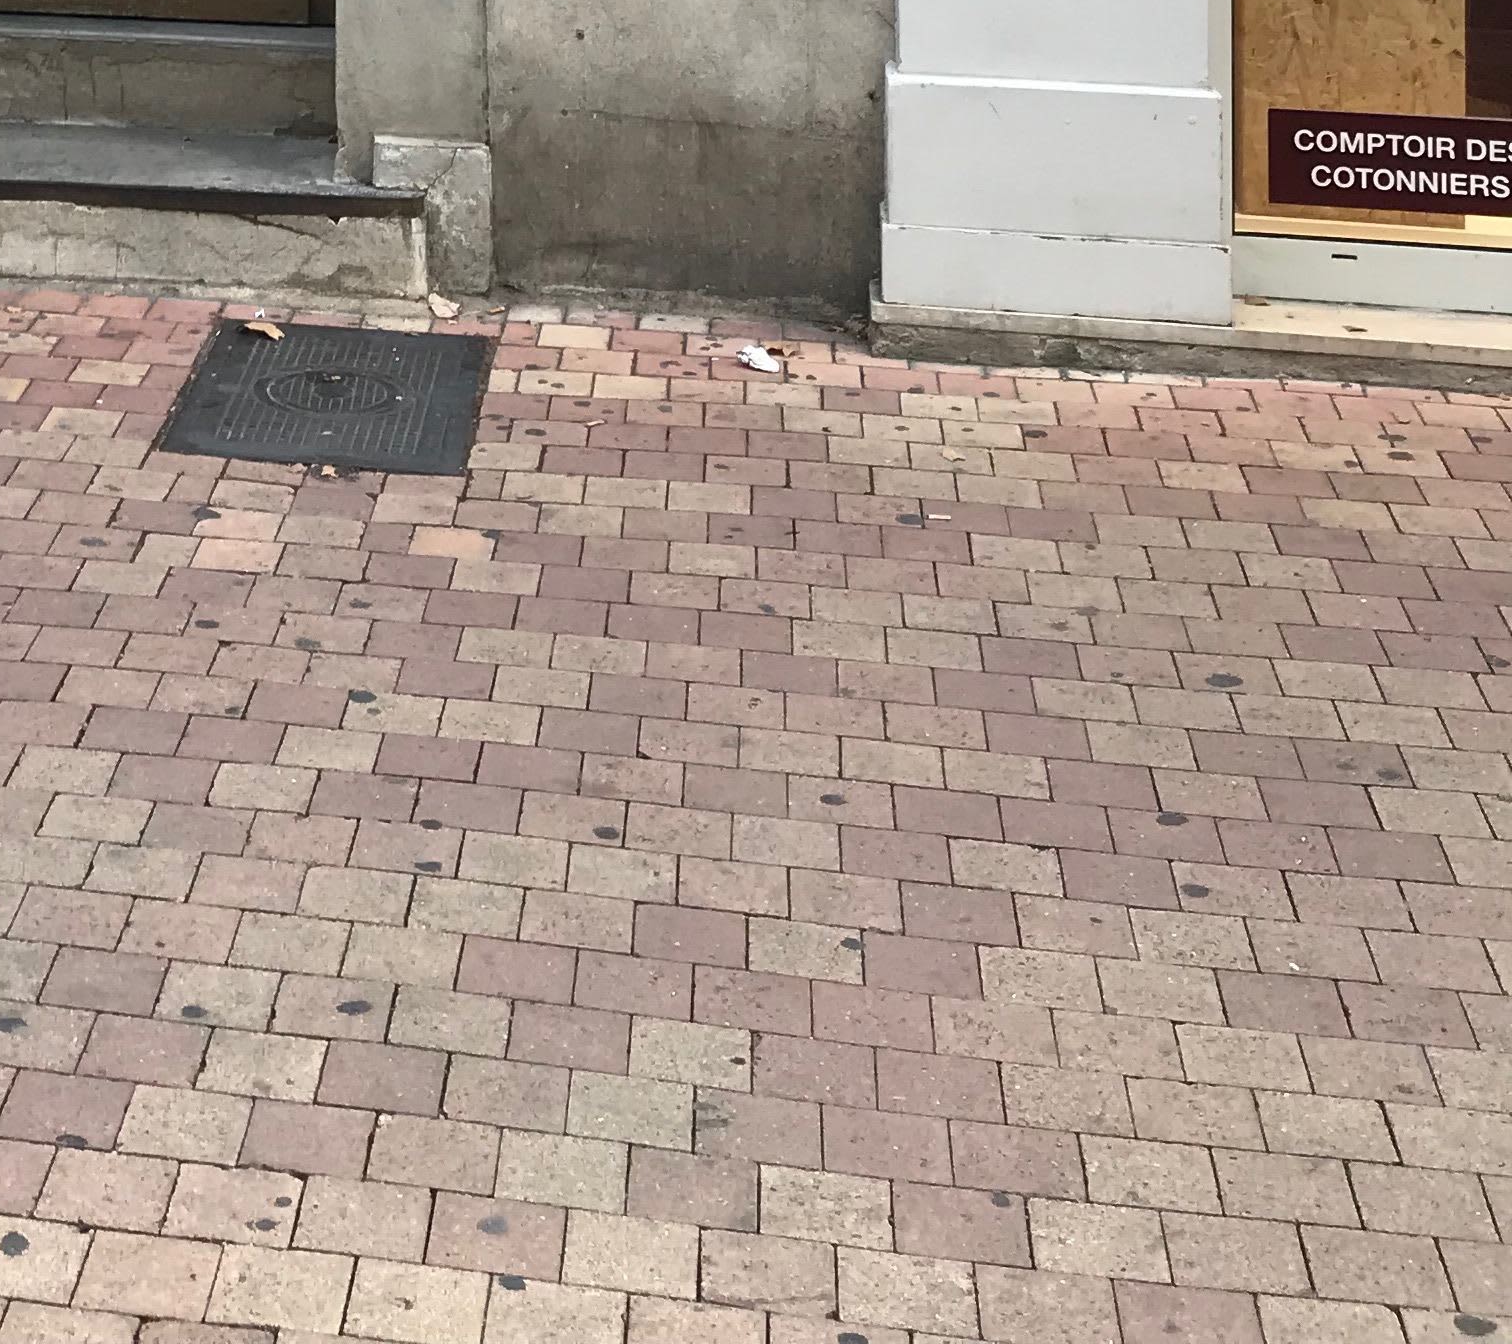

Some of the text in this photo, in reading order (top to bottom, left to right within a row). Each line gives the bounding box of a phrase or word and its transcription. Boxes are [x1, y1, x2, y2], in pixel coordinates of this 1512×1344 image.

[1293, 129, 1512, 163] COMPTOIR DE
[1310, 165, 1510, 199] COTONNIERS
